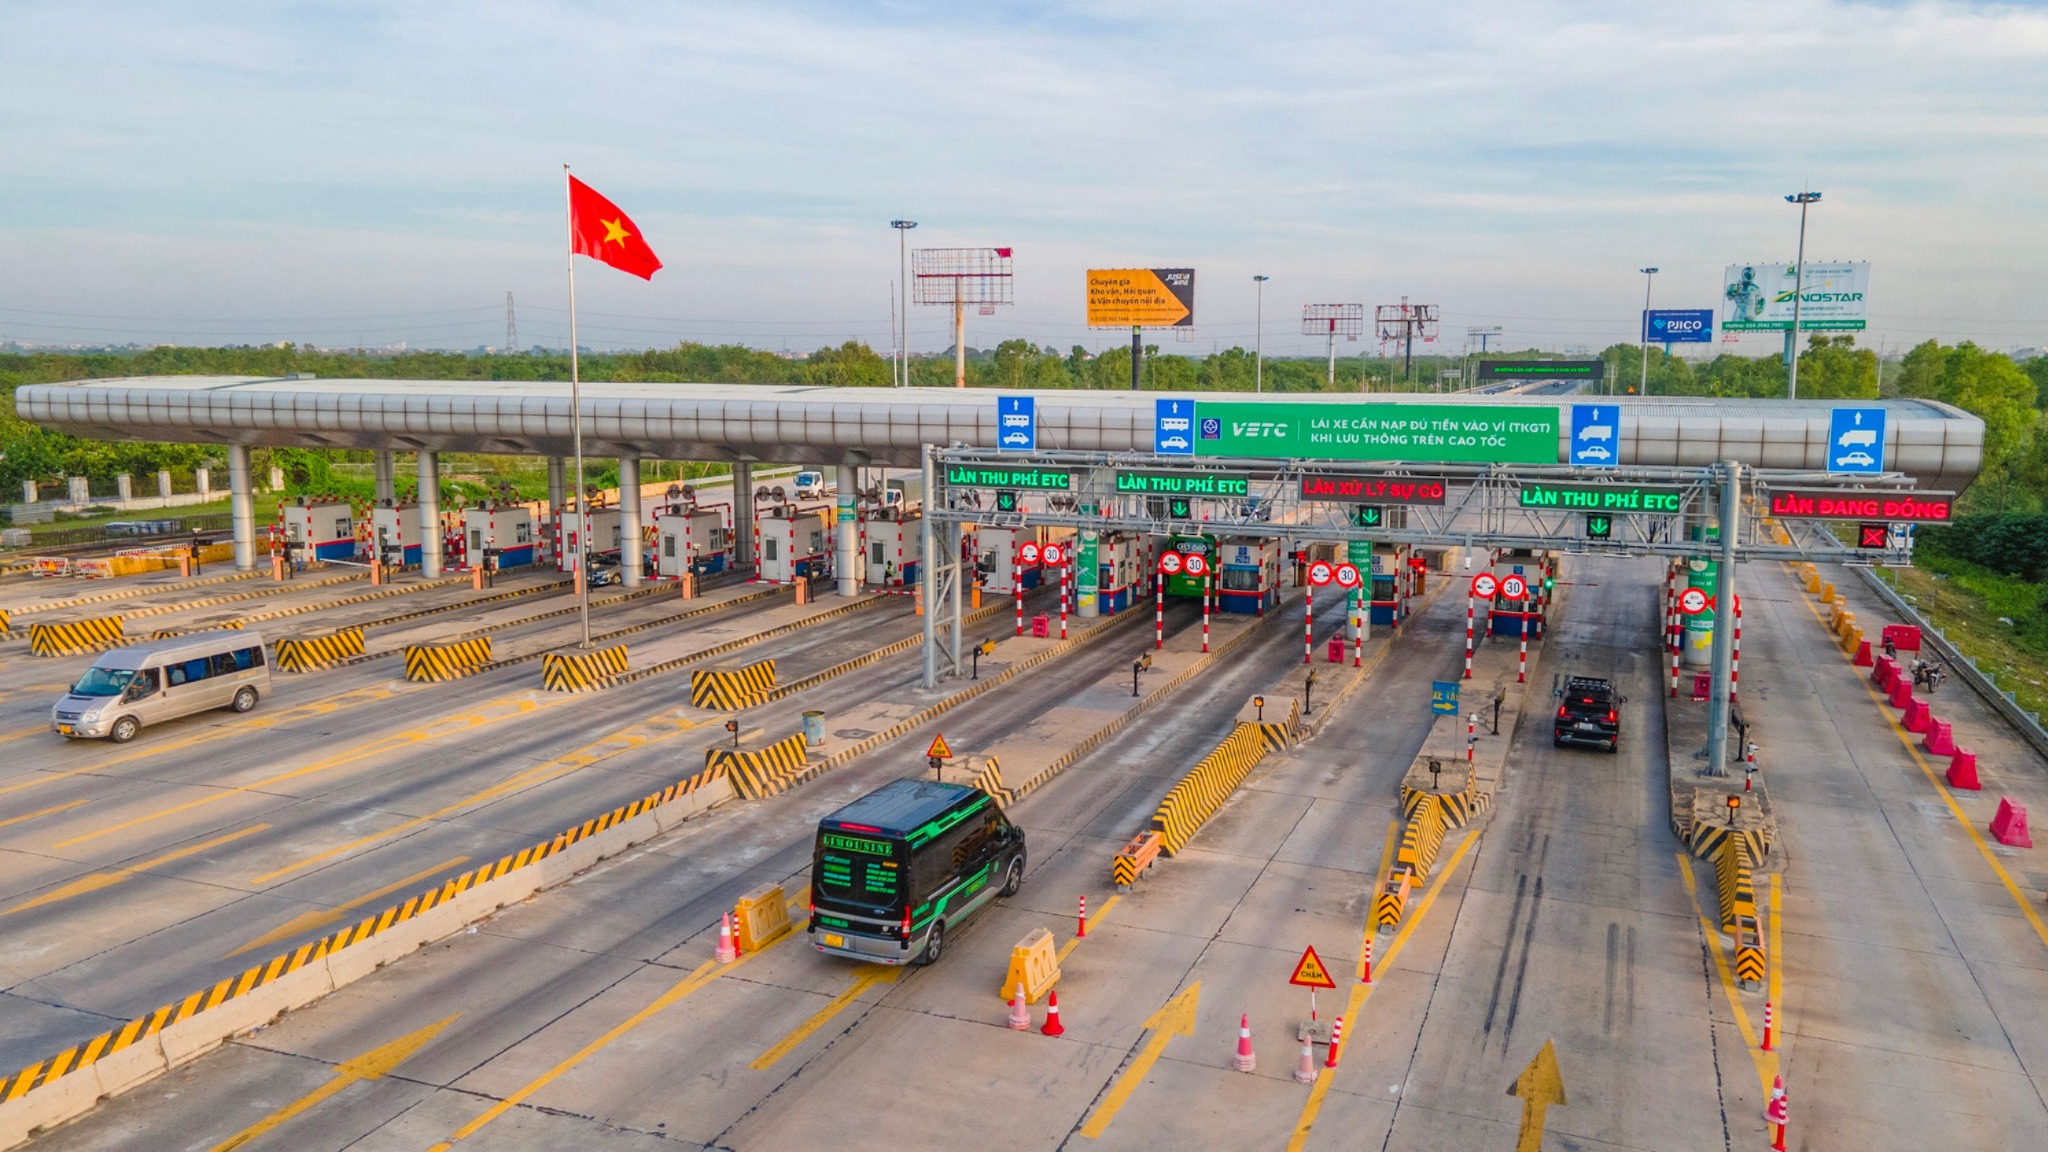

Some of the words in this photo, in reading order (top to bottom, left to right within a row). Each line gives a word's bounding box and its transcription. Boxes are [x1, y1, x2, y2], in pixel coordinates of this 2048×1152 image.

[1090, 278, 1118, 287] Chuyên
[1120, 278, 1130, 287] gia
[1667, 320, 1702, 330] PJICO
[1232, 422, 1288, 438] VETC
[1311, 418, 1330, 429] LÁI
[1333, 420, 1348, 429] XE
[1381, 420, 1406, 432] NẠP
[1410, 418, 1428, 430] ĐỦ
[1462, 420, 1488, 432] VÀO
[1492, 421, 1505, 432] VÍ
[1509, 422, 1550, 434] (TKGT)
[1311, 434, 1332, 443] KHI
[1336, 433, 1360, 444] LƯU
[1364, 433, 1408, 444] THÔNG
[1412, 434, 1444, 445] TRÊN
[1448, 436, 1476, 446] CAO
[1480, 433, 1506, 447] TỐC
[950, 467, 976, 484] LÀN
[980, 472, 1008, 485] THU
[1012, 470, 1038, 486] PHÍ
[1042, 474, 1068, 488] ETC
[1118, 473, 1146, 490] LÀN
[1151, 478, 1181, 492] THU
[1186, 476, 1214, 492] PHÍ
[1218, 480, 1246, 494] ETC
[1303, 478, 1334, 494] LÀN
[1366, 480, 1388, 497] LÝ
[1390, 482, 1416, 500] SỰ
[1522, 486, 1557, 505] LÀN
[1562, 491, 1599, 507] THU
[1604, 489, 1639, 509] PHÍ
[1643, 494, 1679, 510] ETC
[1774, 493, 1813, 514] LÀN
[1818, 499, 1878, 516] ĐANG
[1883, 497, 1948, 519] ĐÓNG
[1046, 549, 1058, 560] 30
[1189, 560, 1202, 570] 30
[1341, 570, 1354, 581] 30
[1506, 582, 1520, 594] 30
[824, 835, 892, 855] LIMOUSINE
